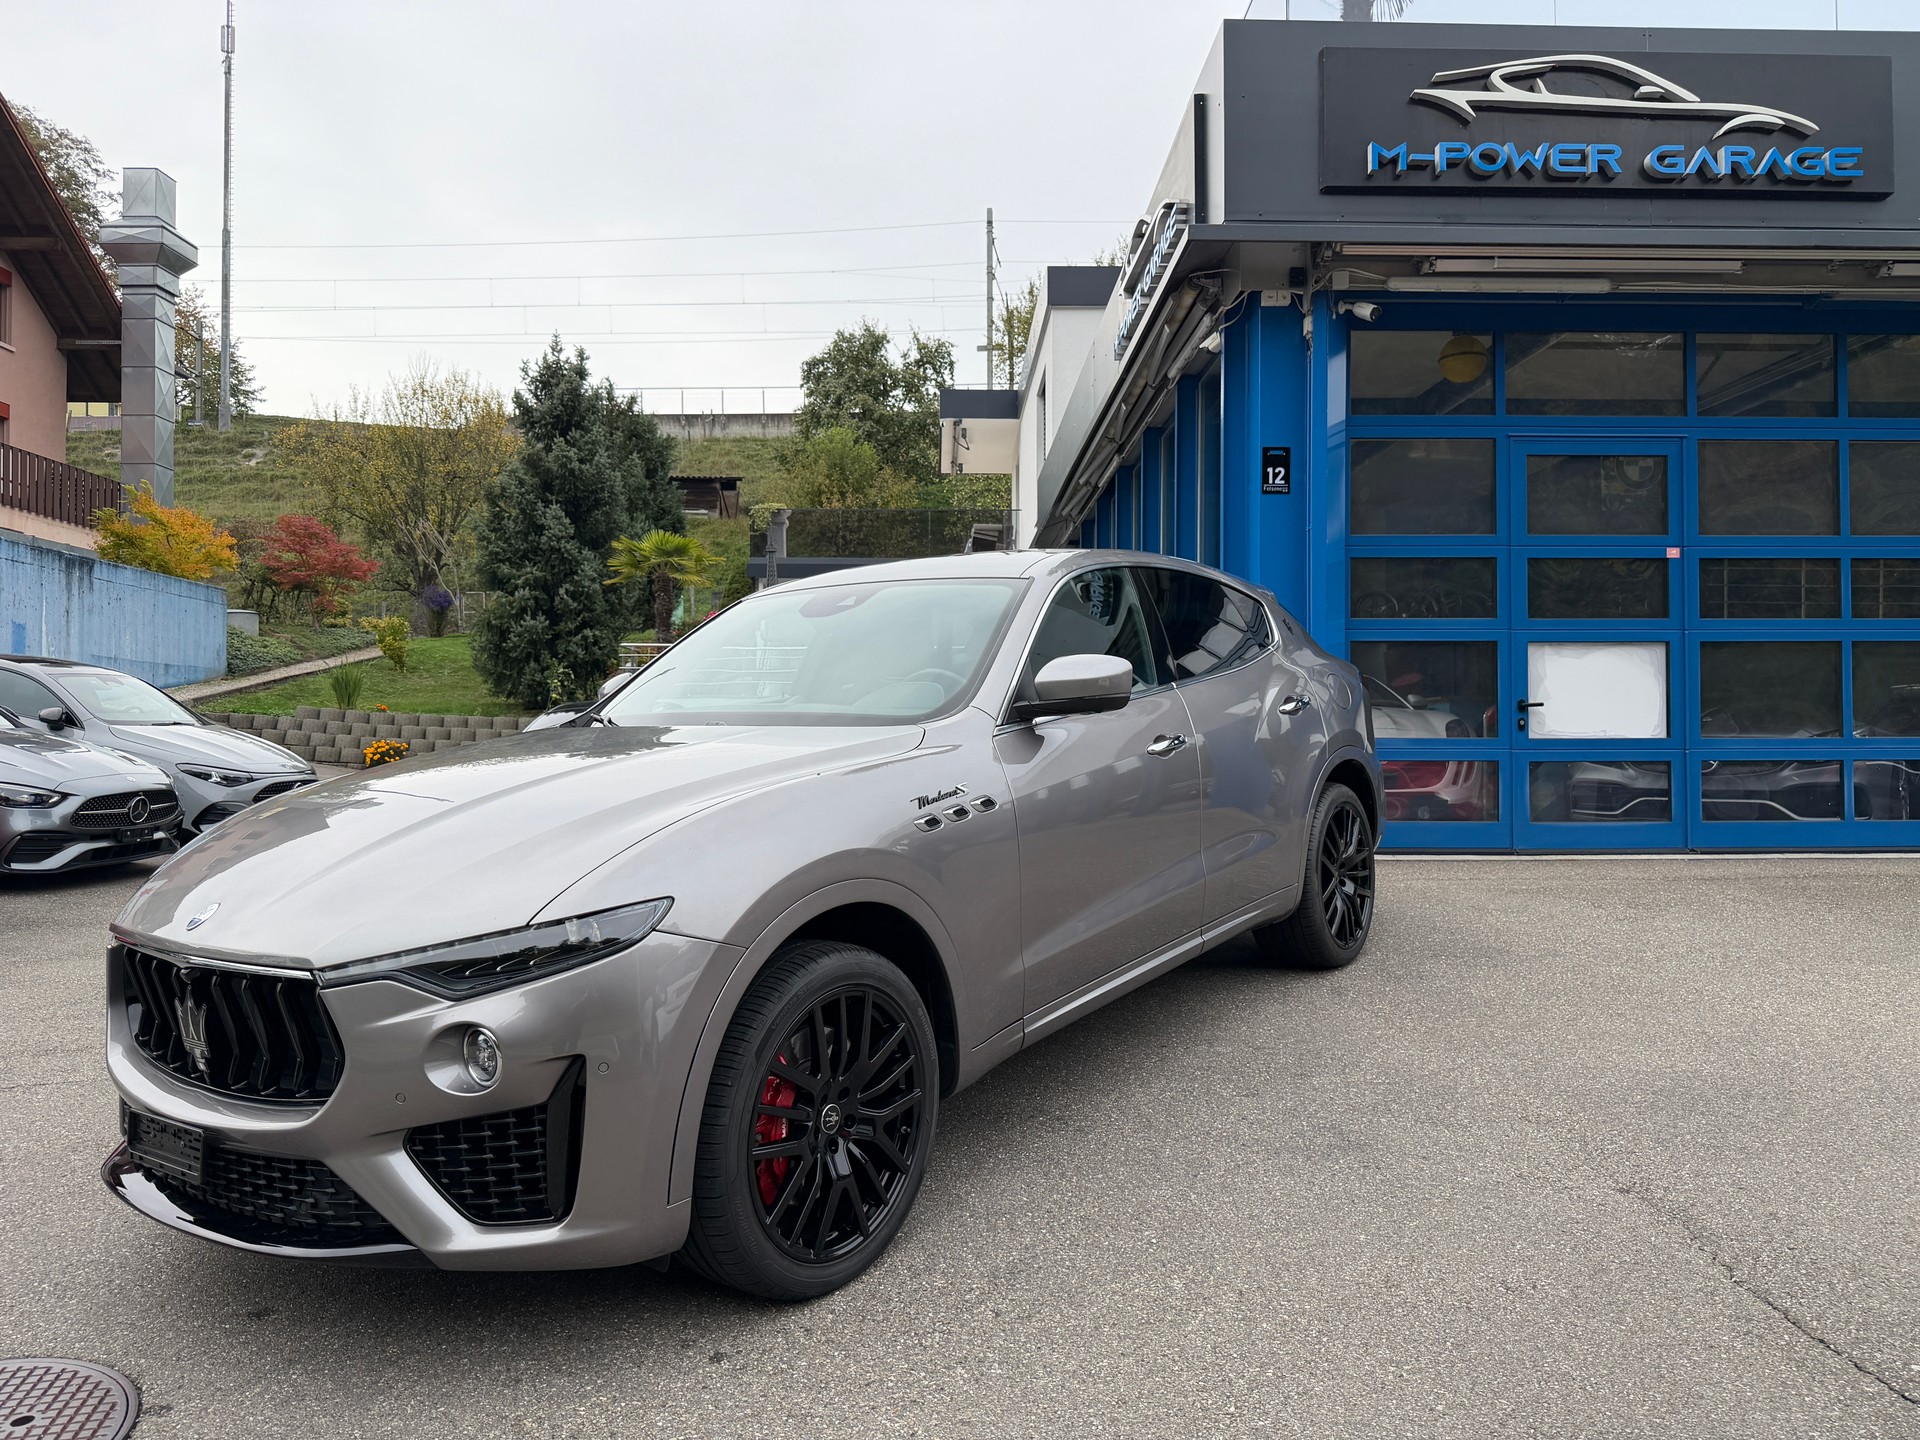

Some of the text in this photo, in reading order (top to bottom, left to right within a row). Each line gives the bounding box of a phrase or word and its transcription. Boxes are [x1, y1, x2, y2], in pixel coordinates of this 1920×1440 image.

[1367, 141, 1864, 178] M-POWER GARAGE
[1267, 467, 1285, 484] 12
